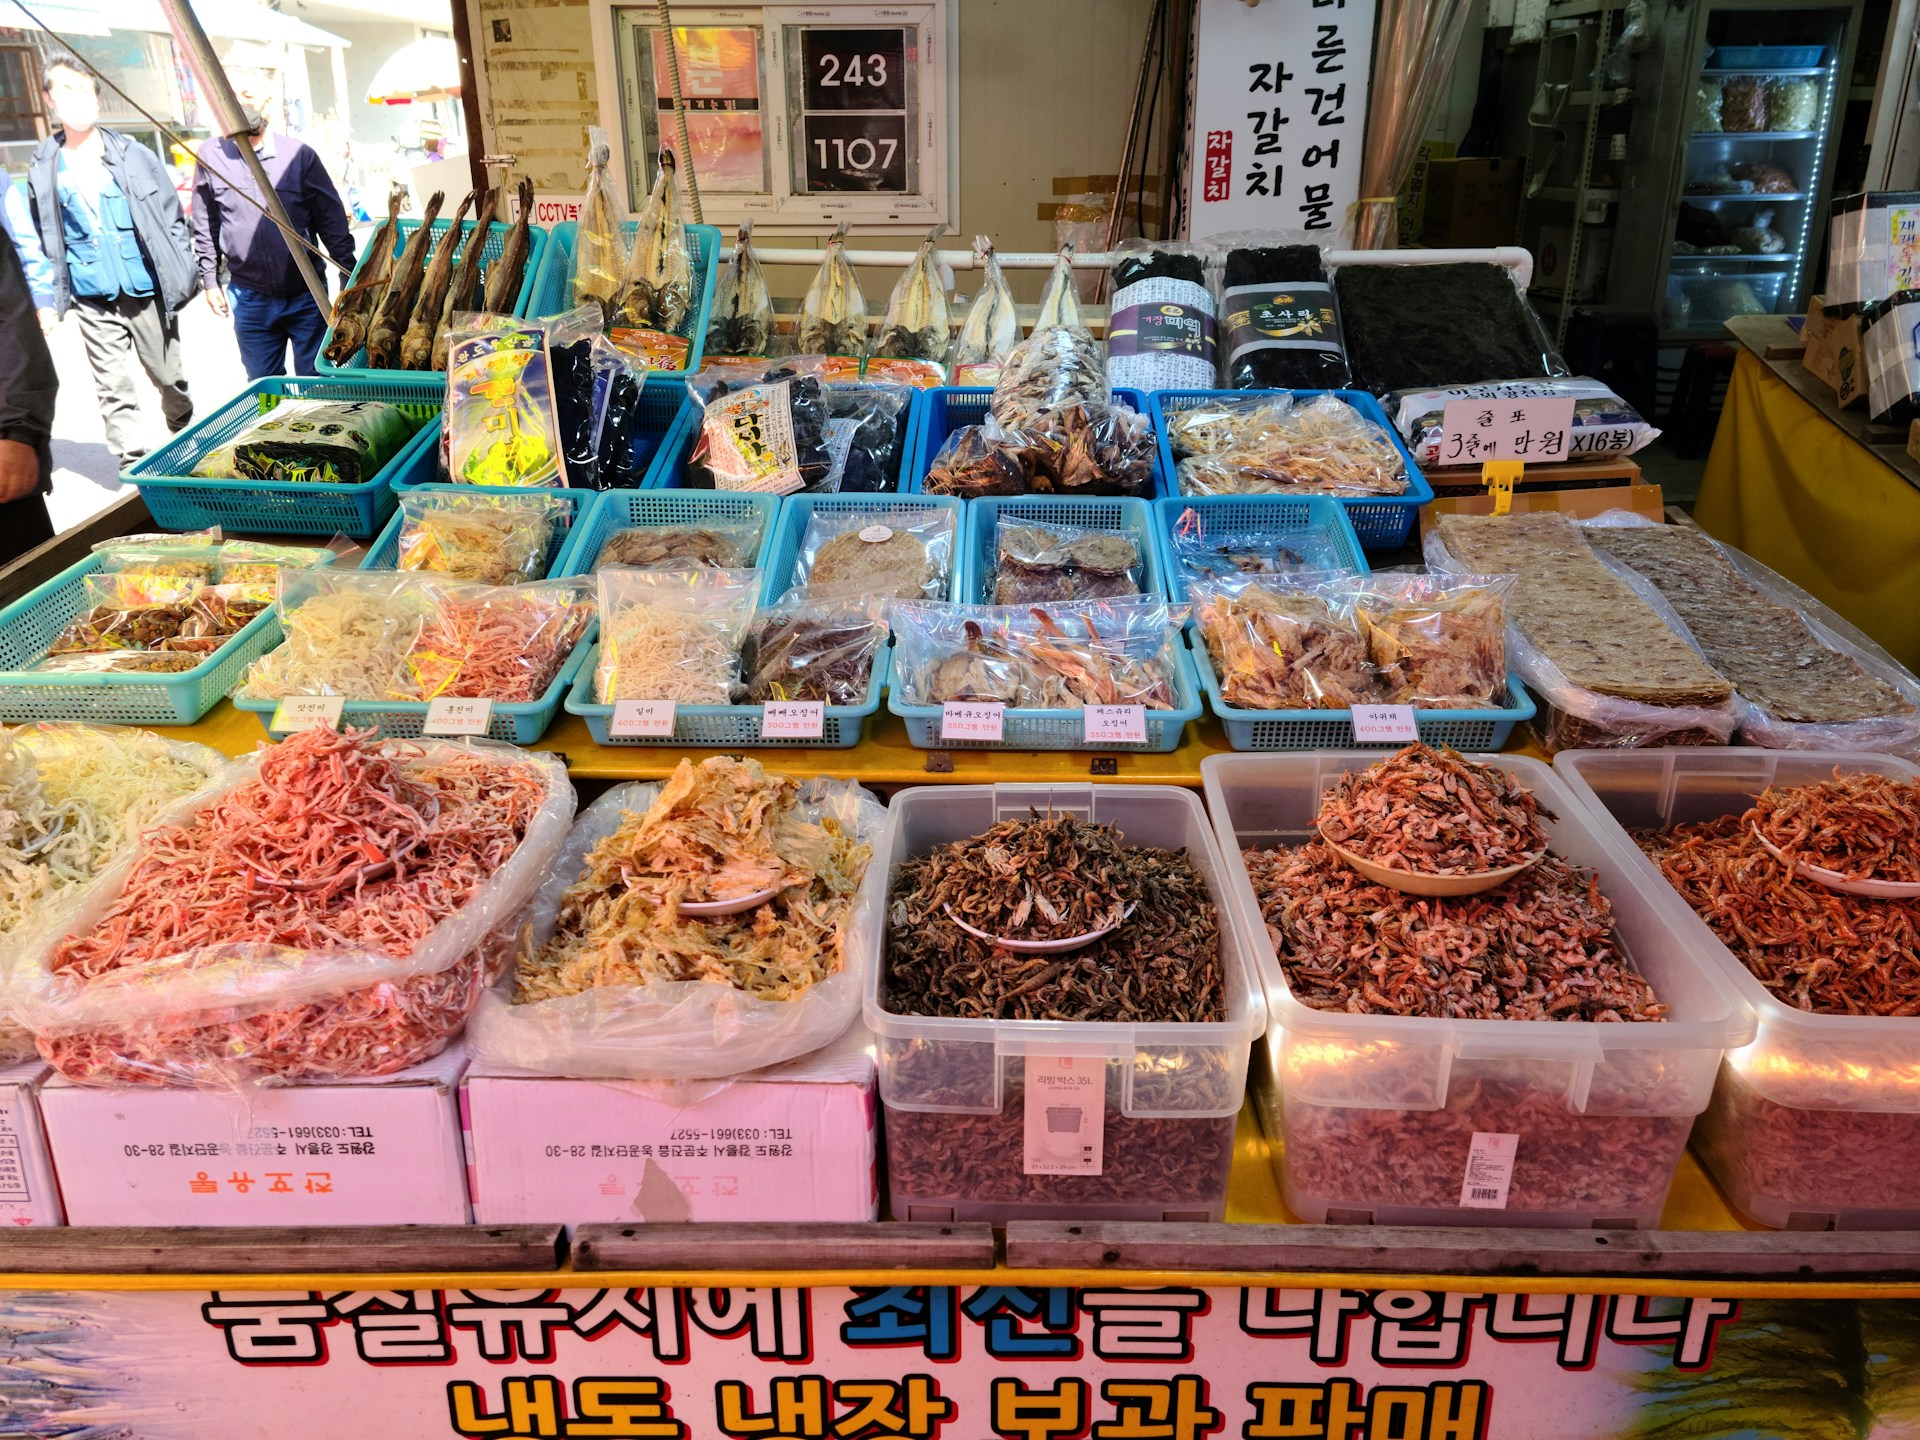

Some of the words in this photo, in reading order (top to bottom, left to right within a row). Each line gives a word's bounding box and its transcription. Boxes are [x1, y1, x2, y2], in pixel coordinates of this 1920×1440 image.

[819, 53, 888, 88] 243
[1298, 0, 1347, 231] 른건어물
[1245, 61, 1294, 198] 자갈치
[813, 138, 899, 171] 1107
[1207, 132, 1232, 199] 자갈치
[538, 203, 582, 222] CCTV녹
[1142, 315, 1164, 326] 기장
[1164, 316, 1201, 337] 미역
[1514, 430, 1563, 455] 만원
[297, 703, 326, 713] 맛진미
[446, 704, 474, 714] 홍진미
[767, 708, 819, 718] 빼빼오징어
[945, 709, 1002, 720] 바베큐오징어
[1369, 712, 1397, 721] 아귀채
[617, 719, 650, 727] 400그램
[653, 719, 669, 728] 만원
[804, 721, 818, 729] 만원
[947, 722, 979, 731] 350그램
[982, 723, 998, 732] 만원
[1101, 719, 1128, 728] 오징어
[1090, 731, 1122, 740] 350그램
[1126, 731, 1141, 739] 만원
[1037, 1075, 1054, 1085] 리빙
[1057, 1076, 1075, 1085] 박스
[1077, 1076, 1093, 1085] 35L
[670, 1128, 760, 1141] 033)661-5527
[124, 1144, 165, 1157] 28-30
[295, 1142, 334, 1155] 강릉시
[336, 1142, 376, 1155] 강원도
[545, 1145, 586, 1157] 28-30
[591, 1144, 653, 1158] 농공단지길
[658, 1144, 709, 1158] 주문진읍
[713, 1144, 751, 1157] 강릉시
[755, 1144, 793, 1157] 강원도
[188, 1170, 334, 1194] 찬호유통
